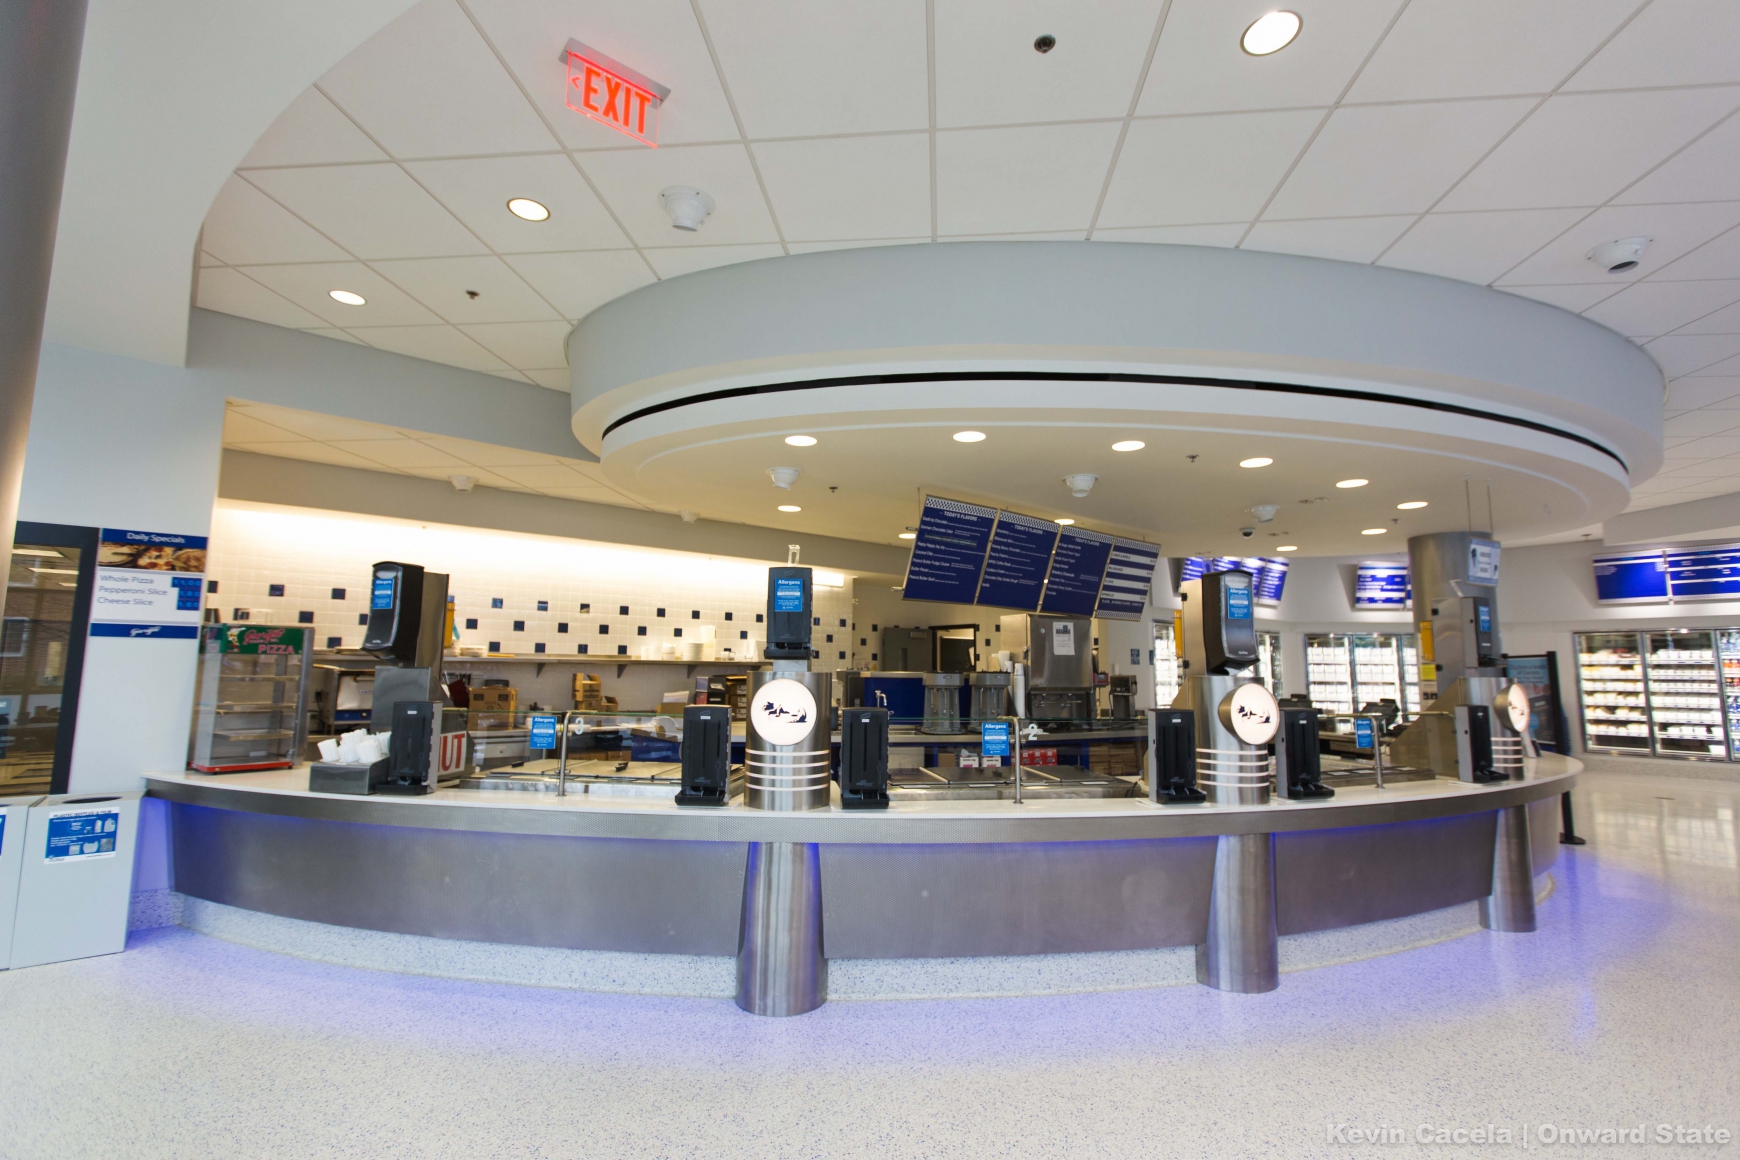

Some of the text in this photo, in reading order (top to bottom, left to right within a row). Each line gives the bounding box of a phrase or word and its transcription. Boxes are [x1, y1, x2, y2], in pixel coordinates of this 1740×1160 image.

[583, 63, 652, 135] EXIT
[944, 511, 960, 519] TODAY'S
[126, 533, 186, 544] Daily Specials
[100, 575, 128, 583] Whole
[98, 586, 168, 596] Pepperoni Slice
[133, 598, 153, 606] Slice
[258, 644, 294, 654] PIZZA
[575, 717, 584, 735] 3
[1028, 724, 1038, 740] 2
